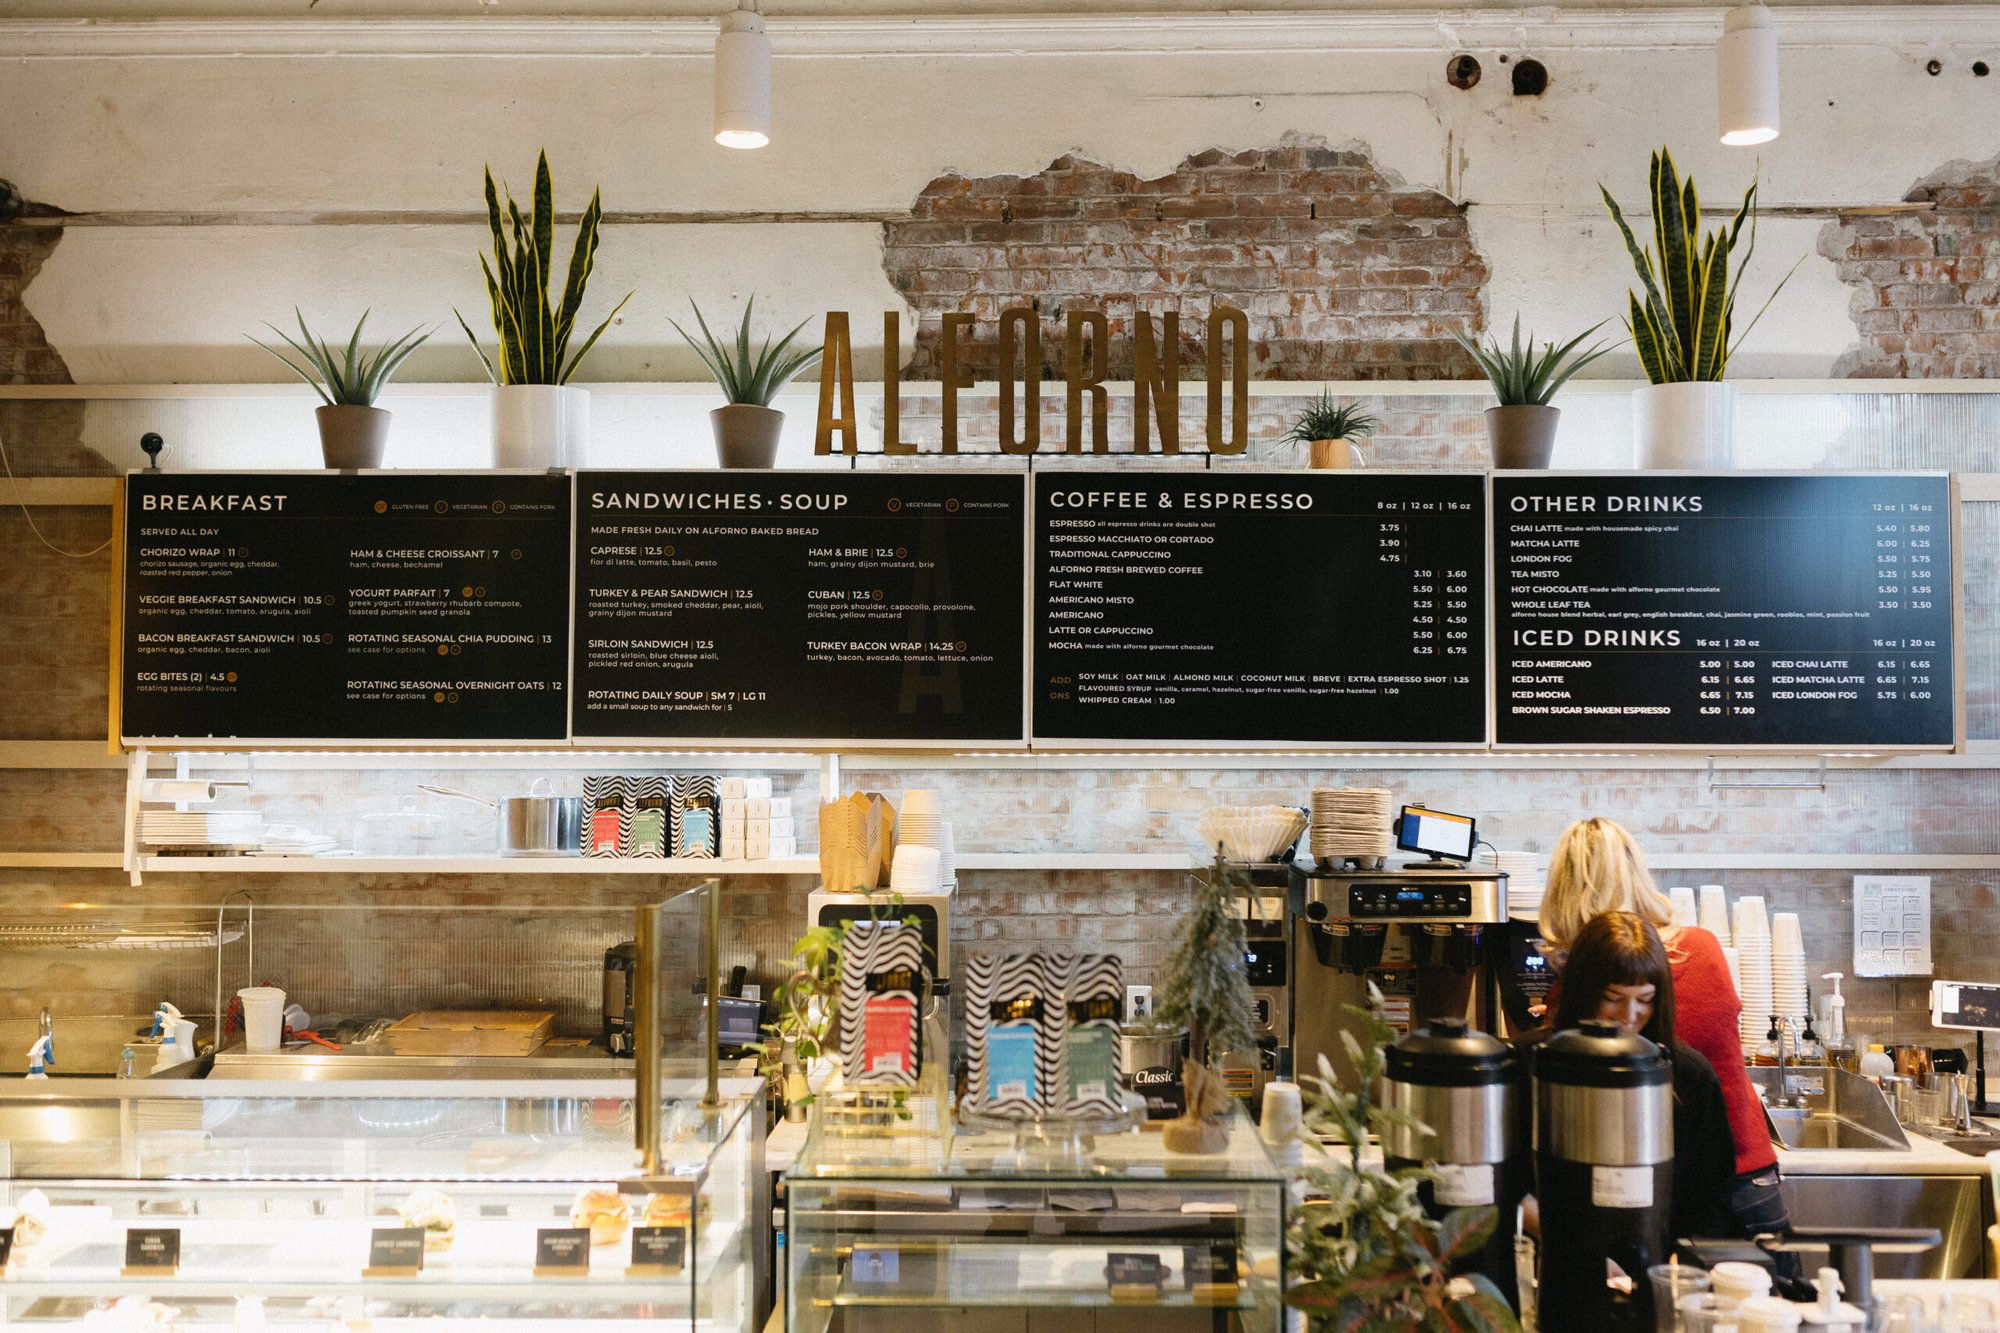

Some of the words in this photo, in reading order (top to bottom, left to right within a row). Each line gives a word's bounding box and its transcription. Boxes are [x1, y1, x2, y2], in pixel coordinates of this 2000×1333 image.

[814, 307, 1248, 455] ALFORNO
[143, 495, 287, 511] BREAKFAST
[592, 493, 761, 509] SANDWICHES
[780, 494, 847, 510] SOUP
[1050, 492, 1147, 508] COFFEE
[1158, 492, 1172, 508] &
[1184, 493, 1313, 509] ESPRESSO
[1511, 496, 1596, 512] OTHER
[1608, 496, 1703, 512] DRINKS
[1447, 502, 1457, 510] 16
[141, 528, 178, 536] SERVED
[180, 528, 197, 536] ALL
[200, 528, 219, 536] DAY
[591, 526, 618, 534] MADE
[621, 526, 652, 534] FRESH
[702, 527, 748, 535] ALFORNO
[751, 527, 783, 535] BAKED
[1050, 535, 1096, 543] ESPRESSO
[1169, 536, 1214, 544] CORTADO
[1380, 539, 1400, 547] 3.90
[140, 548, 186, 556] CHORIZO
[189, 548, 220, 556] WRAP
[228, 548, 235, 556] 11
[351, 550, 374, 558] HAM
[376, 550, 383, 558] &
[386, 550, 425, 558] CHEESE
[427, 550, 485, 558] CROISSANT
[492, 550, 499, 558] 7
[590, 546, 637, 555] CAPRESE
[645, 547, 662, 555] 12.5
[1049, 550, 1109, 558] TRADITIONAL
[1111, 551, 1171, 559] CAPPUCCINO
[1511, 555, 1551, 563] LONDON
[1126, 566, 1166, 574] BREWED
[1168, 566, 1203, 574] COFFEE
[1447, 570, 1467, 578] 3.60
[349, 589, 391, 597] YOGURT
[393, 589, 436, 597] PARFAIT
[443, 589, 450, 597] 7
[1413, 585, 1433, 593] 5.50
[1446, 585, 1467, 593] 6.00
[139, 595, 175, 604] VEGGIE
[178, 595, 237, 604] BREAKFAST
[239, 596, 296, 604] SANDWICH
[304, 596, 322, 604] 10.5
[808, 591, 844, 599] CUBAN
[852, 591, 870, 599] 12.5
[138, 607, 168, 616] organic
[348, 634, 399, 642] ROTATING
[402, 634, 456, 643] SEASONAL
[458, 634, 483, 643] CHIA
[486, 635, 534, 643] PUDDING
[542, 635, 552, 643] 13
[1514, 630, 1573, 646] ICED
[1585, 630, 1680, 646] DRINKS
[1696, 639, 1707, 647] 16
[588, 640, 628, 648] SIRLOIN
[631, 640, 688, 649] SANDWICH
[696, 640, 714, 649] 12.5
[807, 641, 847, 650] TURKEY
[850, 642, 887, 650] BACON
[890, 642, 922, 650] WRAP
[929, 642, 954, 651] 14.25
[1413, 646, 1433, 654] 6.25
[1512, 660, 1534, 668] ICED
[1535, 660, 1592, 668] AMERICANO
[137, 672, 158, 681] EGG
[160, 672, 188, 681] BITES
[190, 673, 202, 682] (2)
[210, 673, 225, 681] 4.5
[588, 691, 639, 699] ROTATING
[642, 691, 672, 699] DAILY
[674, 691, 703, 700] SOUP
[711, 692, 726, 700] SM
[728, 692, 735, 700] 7
[743, 692, 756, 700] LG
[758, 692, 766, 700] 11
[1512, 706, 1549, 714] BROWN
[1550, 706, 1582, 714] SUGAR
[1583, 706, 1622, 714] SHAKEN
[1135, 1070, 1174, 1084] Classic
